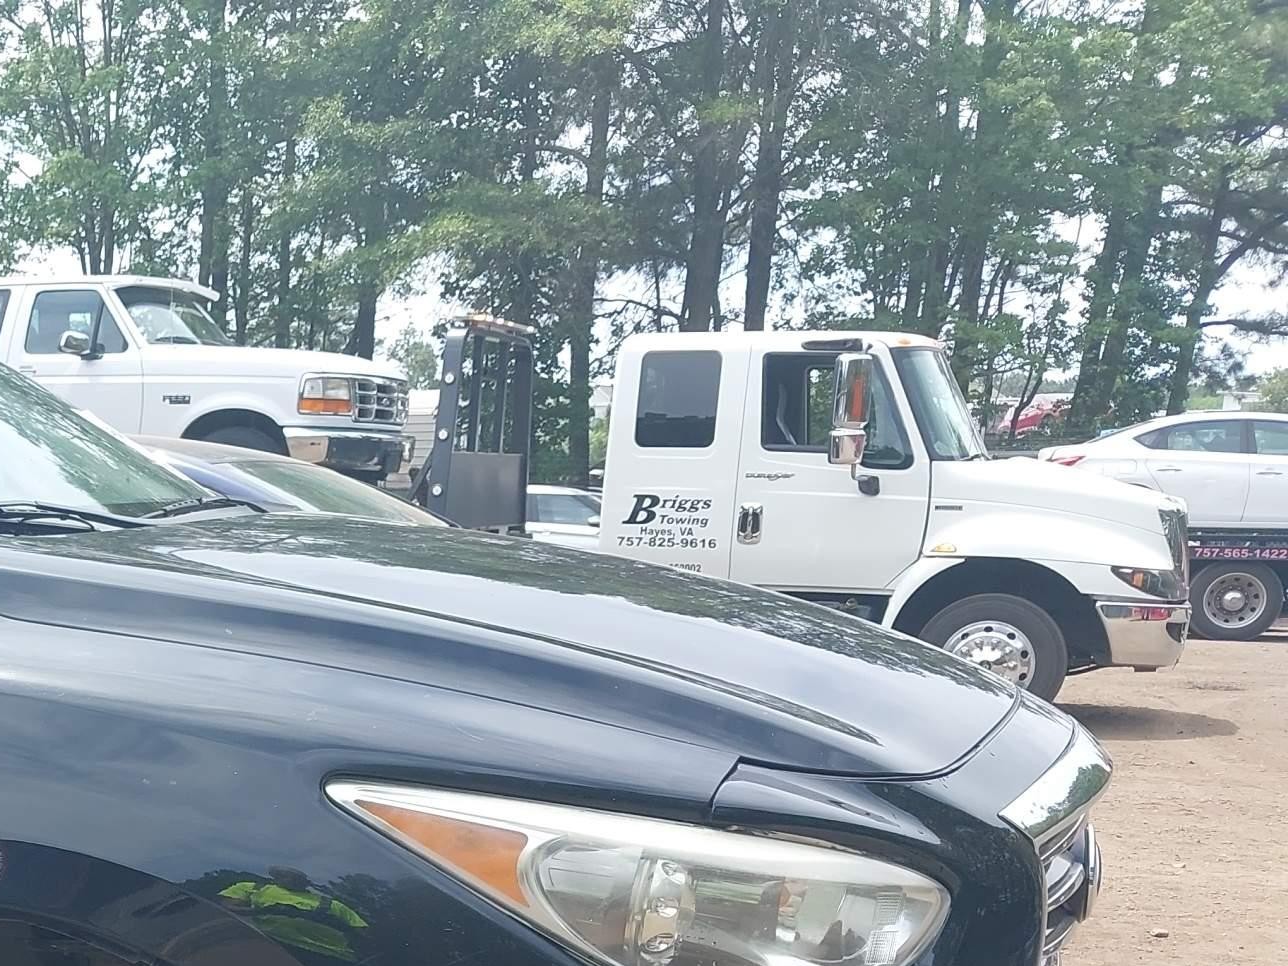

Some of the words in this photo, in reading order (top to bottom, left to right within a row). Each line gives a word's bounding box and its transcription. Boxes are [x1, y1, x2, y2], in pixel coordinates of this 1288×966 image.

[622, 494, 712, 524] Briggs
[659, 515, 709, 528] Towing
[640, 526, 676, 537] Hayes,
[679, 527, 694, 536] VA
[617, 536, 717, 548] 757-825-9616
[1194, 547, 1288, 559] 757-565-1422
